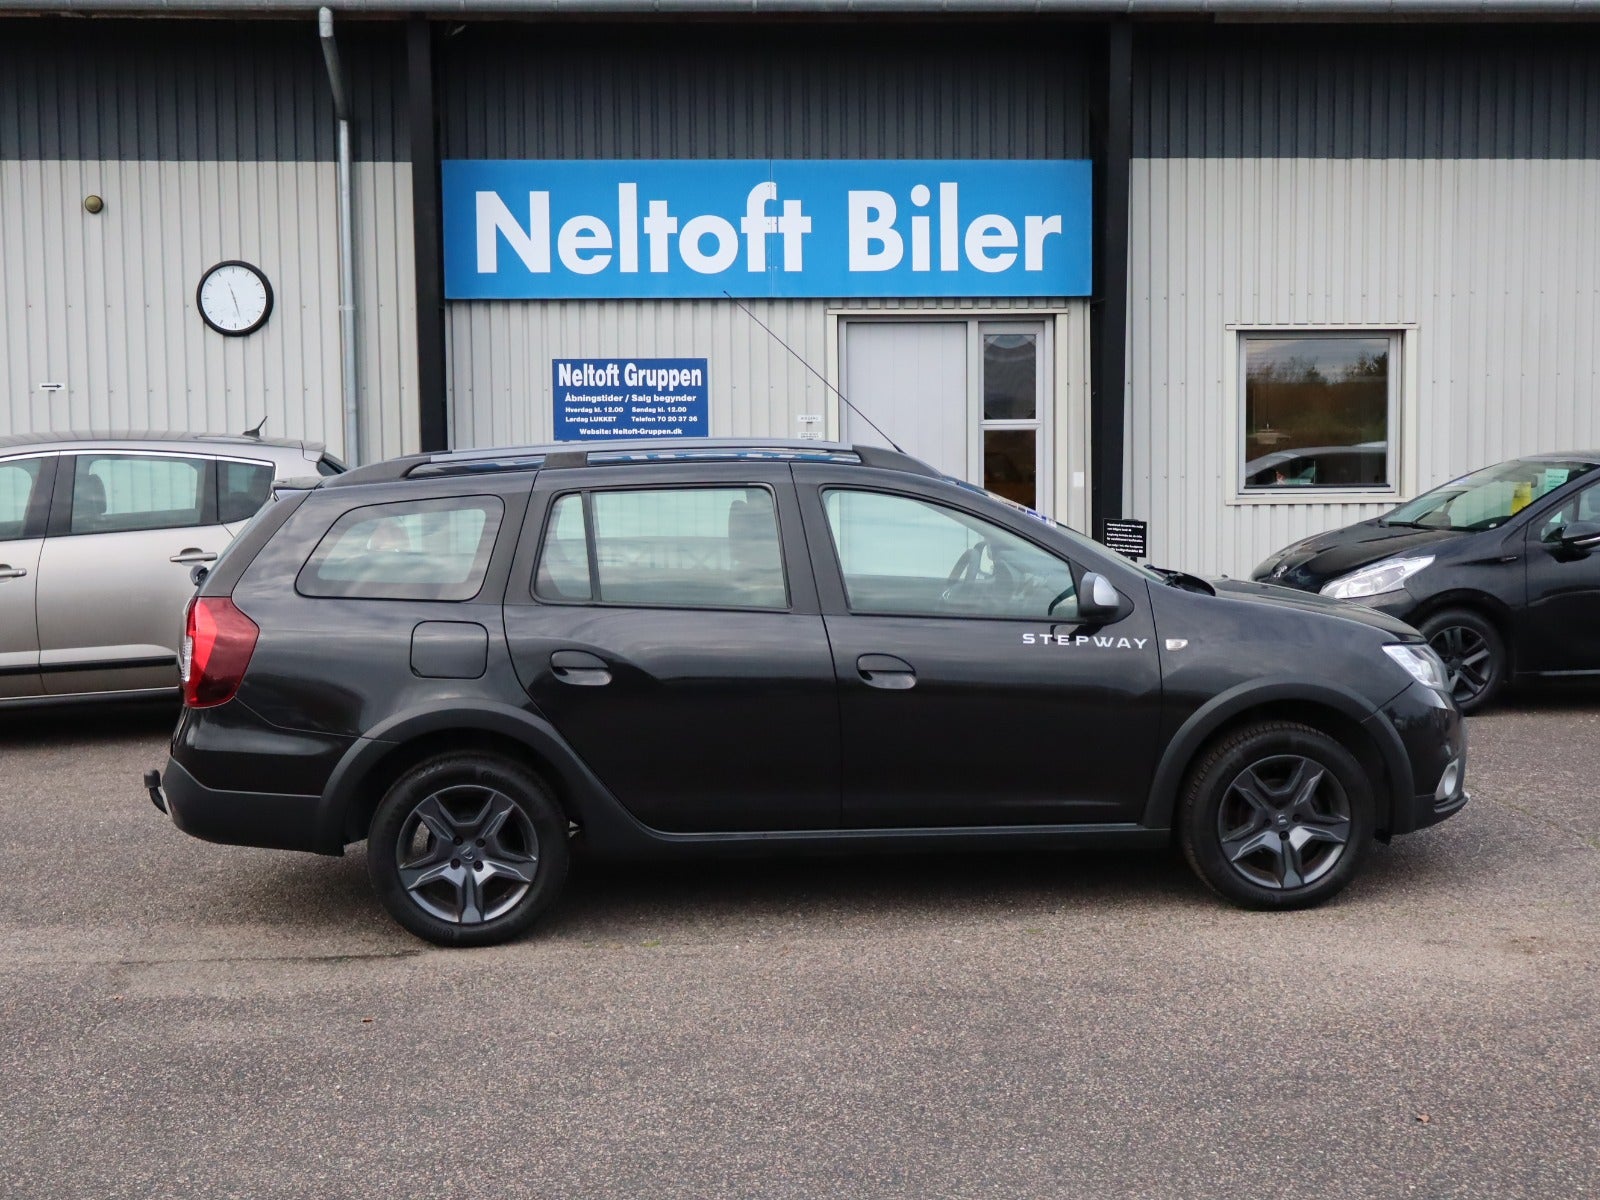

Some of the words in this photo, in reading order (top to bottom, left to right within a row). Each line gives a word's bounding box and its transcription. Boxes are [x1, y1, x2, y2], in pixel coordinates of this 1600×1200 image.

[475, 181, 812, 275] Neltoft
[847, 181, 1063, 275] Biler
[558, 363, 620, 387] Neltoft
[624, 362, 702, 391] Gruppen
[565, 393, 623, 402] Åbningstider
[631, 394, 652, 402] Salg
[653, 394, 697, 402] begynder
[565, 406, 593, 414] Hverdag
[631, 406, 656, 414] Søndag
[565, 415, 589, 423] Lørdag
[589, 415, 617, 423] LUKKET
[631, 415, 656, 423] Telefon
[657, 415, 667, 423] 70
[667, 415, 677, 423] 20
[678, 415, 687, 423] 37
[579, 427, 612, 436] Website:
[1022, 633, 1148, 649] STEPWAY
